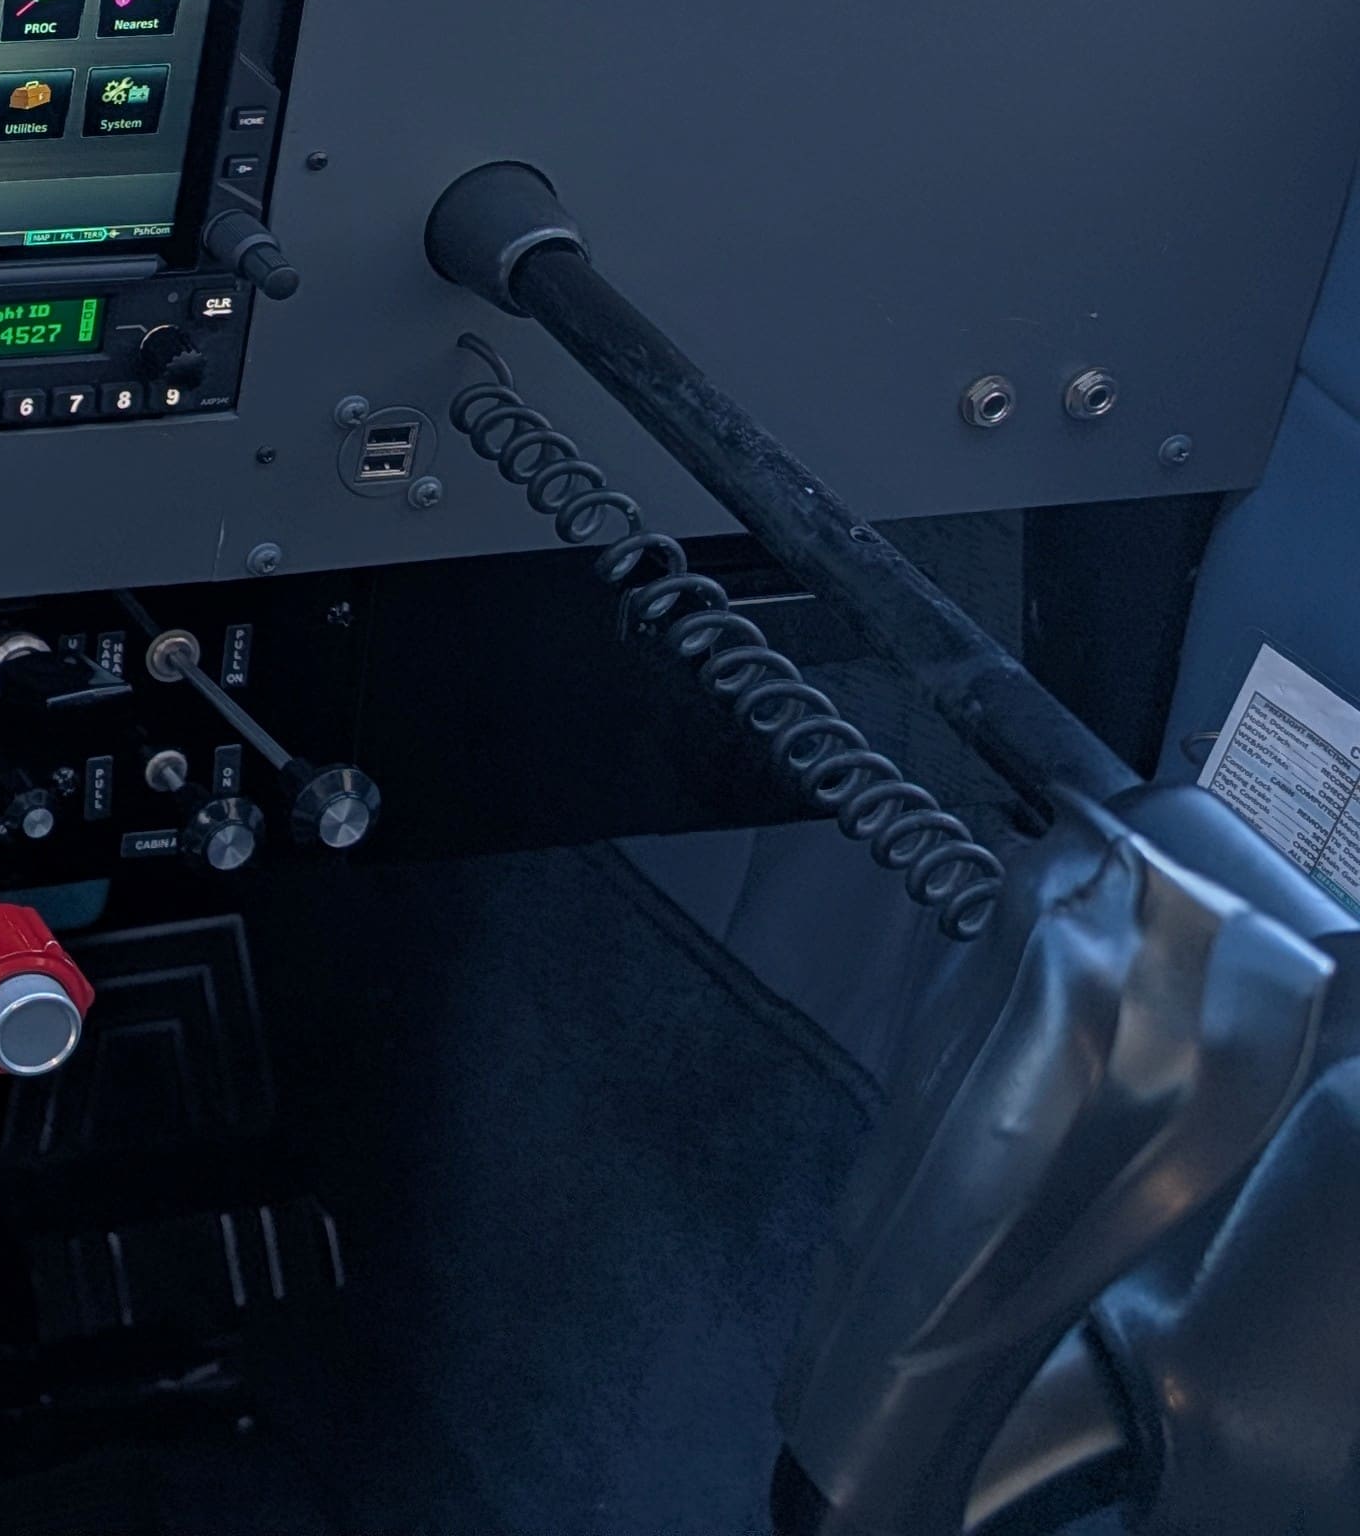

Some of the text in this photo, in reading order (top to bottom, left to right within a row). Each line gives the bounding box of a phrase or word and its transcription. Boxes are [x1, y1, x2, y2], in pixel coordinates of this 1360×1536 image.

[24, 22, 57, 35] PROC
[113, 17, 159, 32] Nearest
[4, 120, 48, 135] Utilities
[100, 117, 142, 132] System
[206, 297, 231, 310] CLR
[28, 303, 51, 320] ID
